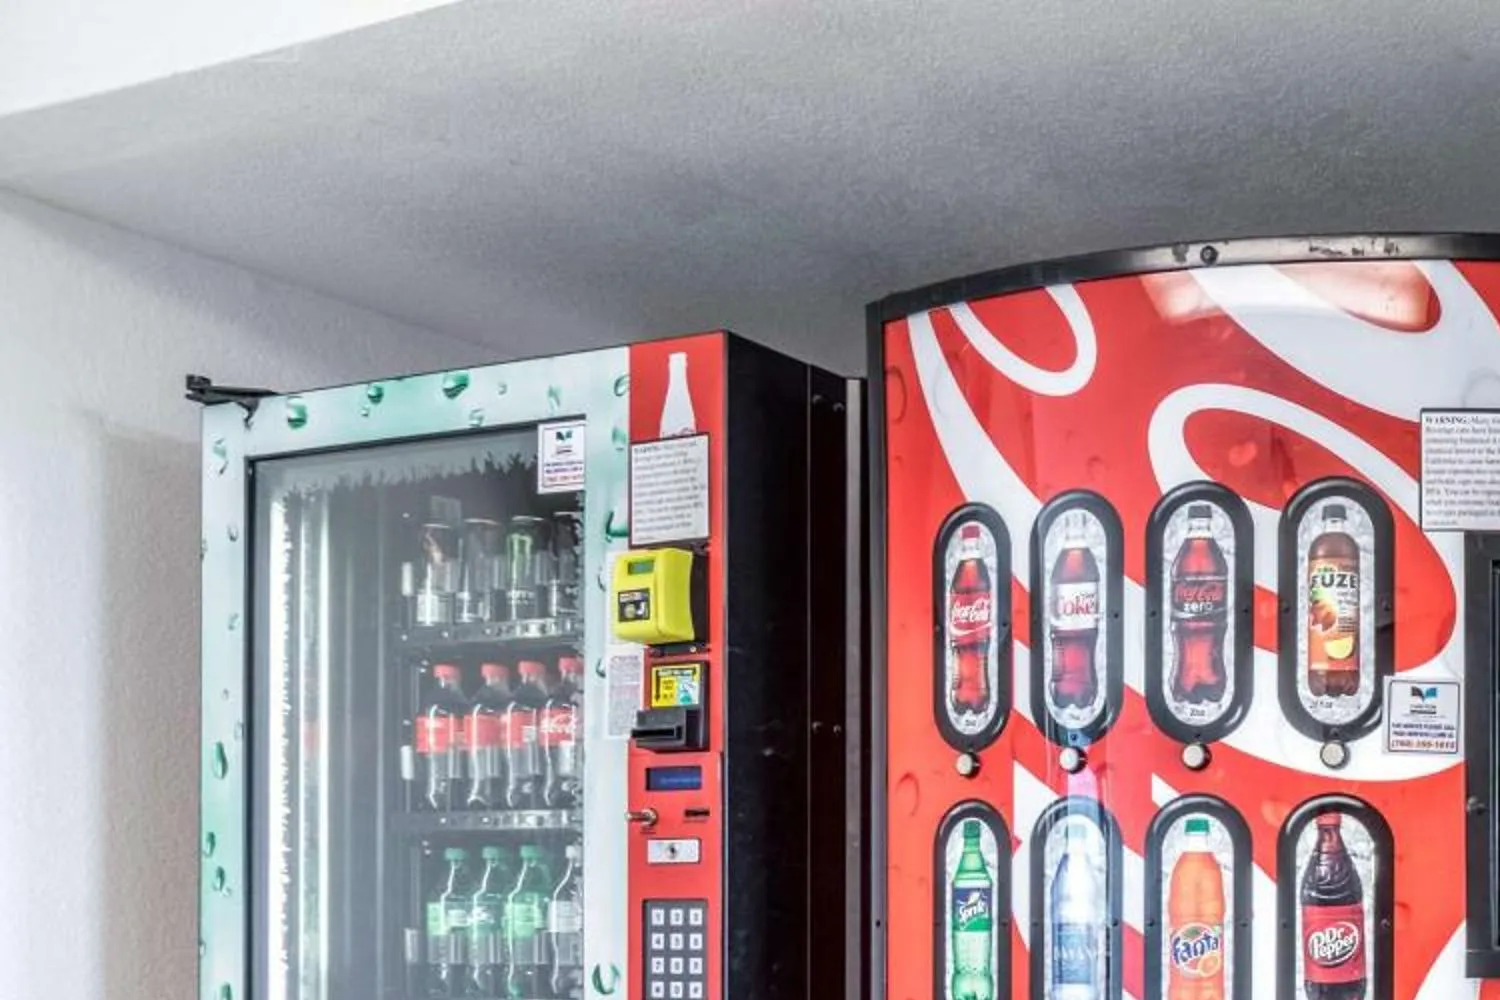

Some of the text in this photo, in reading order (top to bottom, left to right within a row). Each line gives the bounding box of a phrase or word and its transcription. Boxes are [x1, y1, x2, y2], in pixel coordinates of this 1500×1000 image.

[1310, 572, 1358, 590] FUZE
[1183, 600, 1213, 613] zero
[1325, 926, 1345, 942] Dr
[1309, 931, 1359, 960] Pepper
